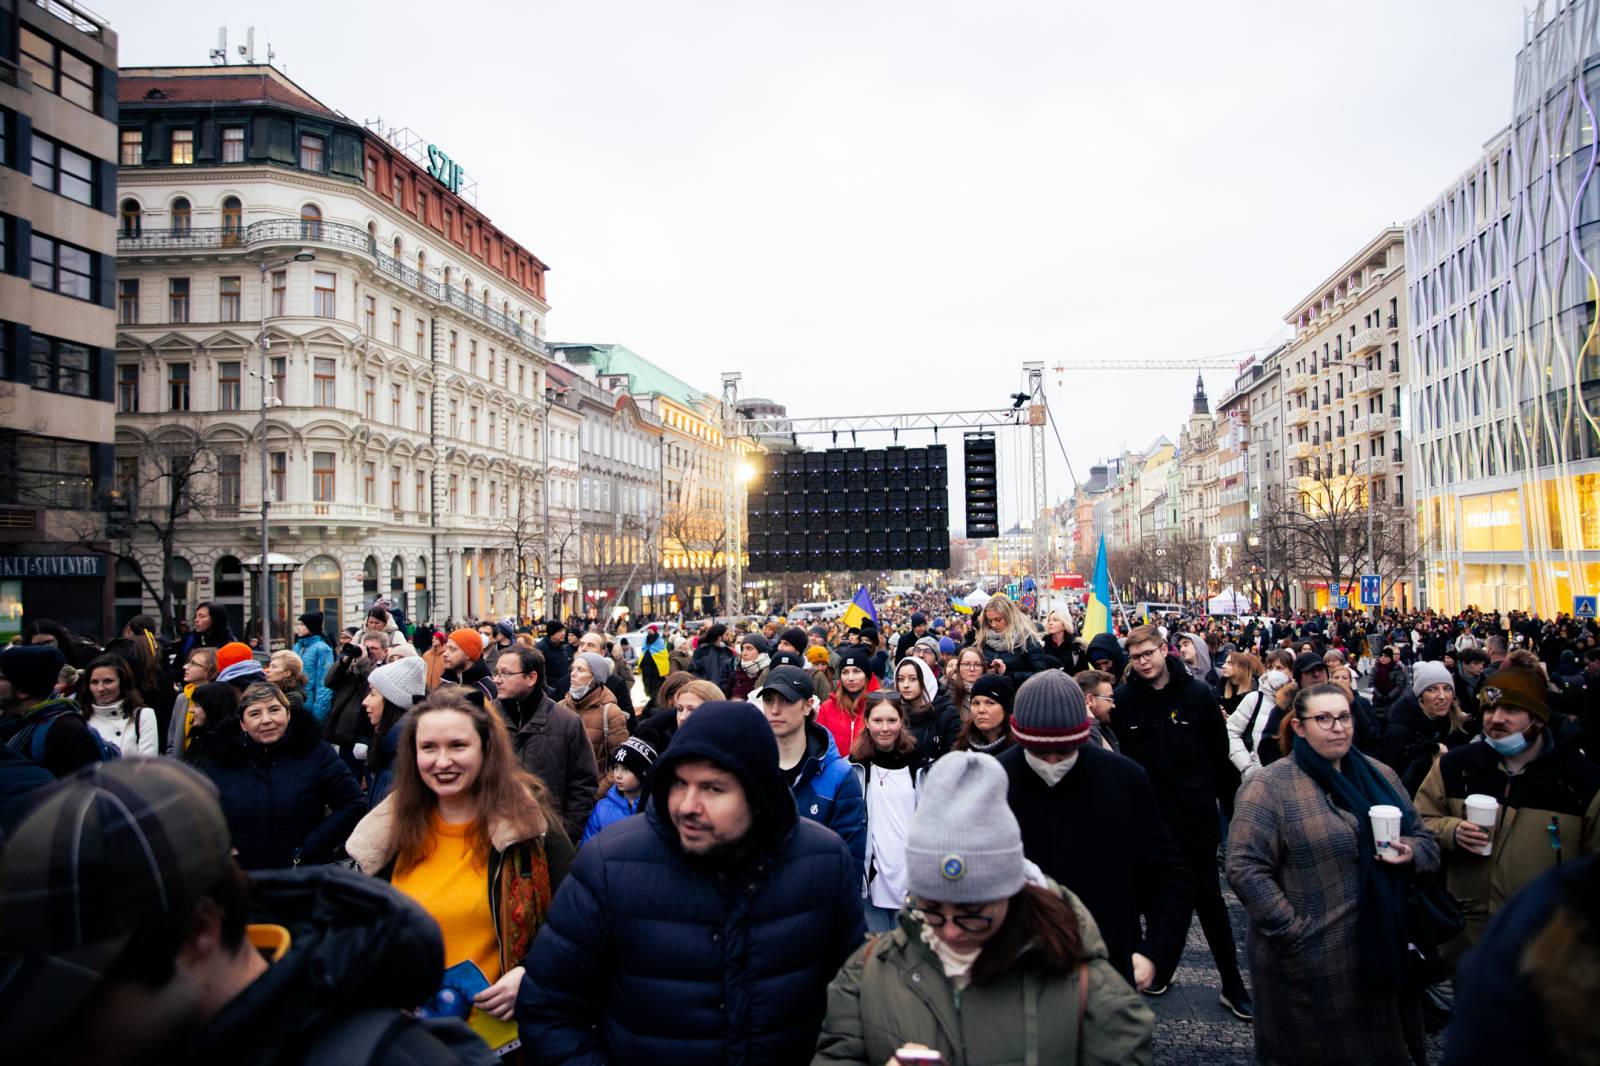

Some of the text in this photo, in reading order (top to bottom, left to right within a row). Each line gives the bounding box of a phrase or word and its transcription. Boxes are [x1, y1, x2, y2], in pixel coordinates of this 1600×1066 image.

[427, 144, 464, 194] SZIF
[1340, 597, 1347, 606] P
[614, 748, 628, 762] NY
[627, 739, 651, 757] KEES
